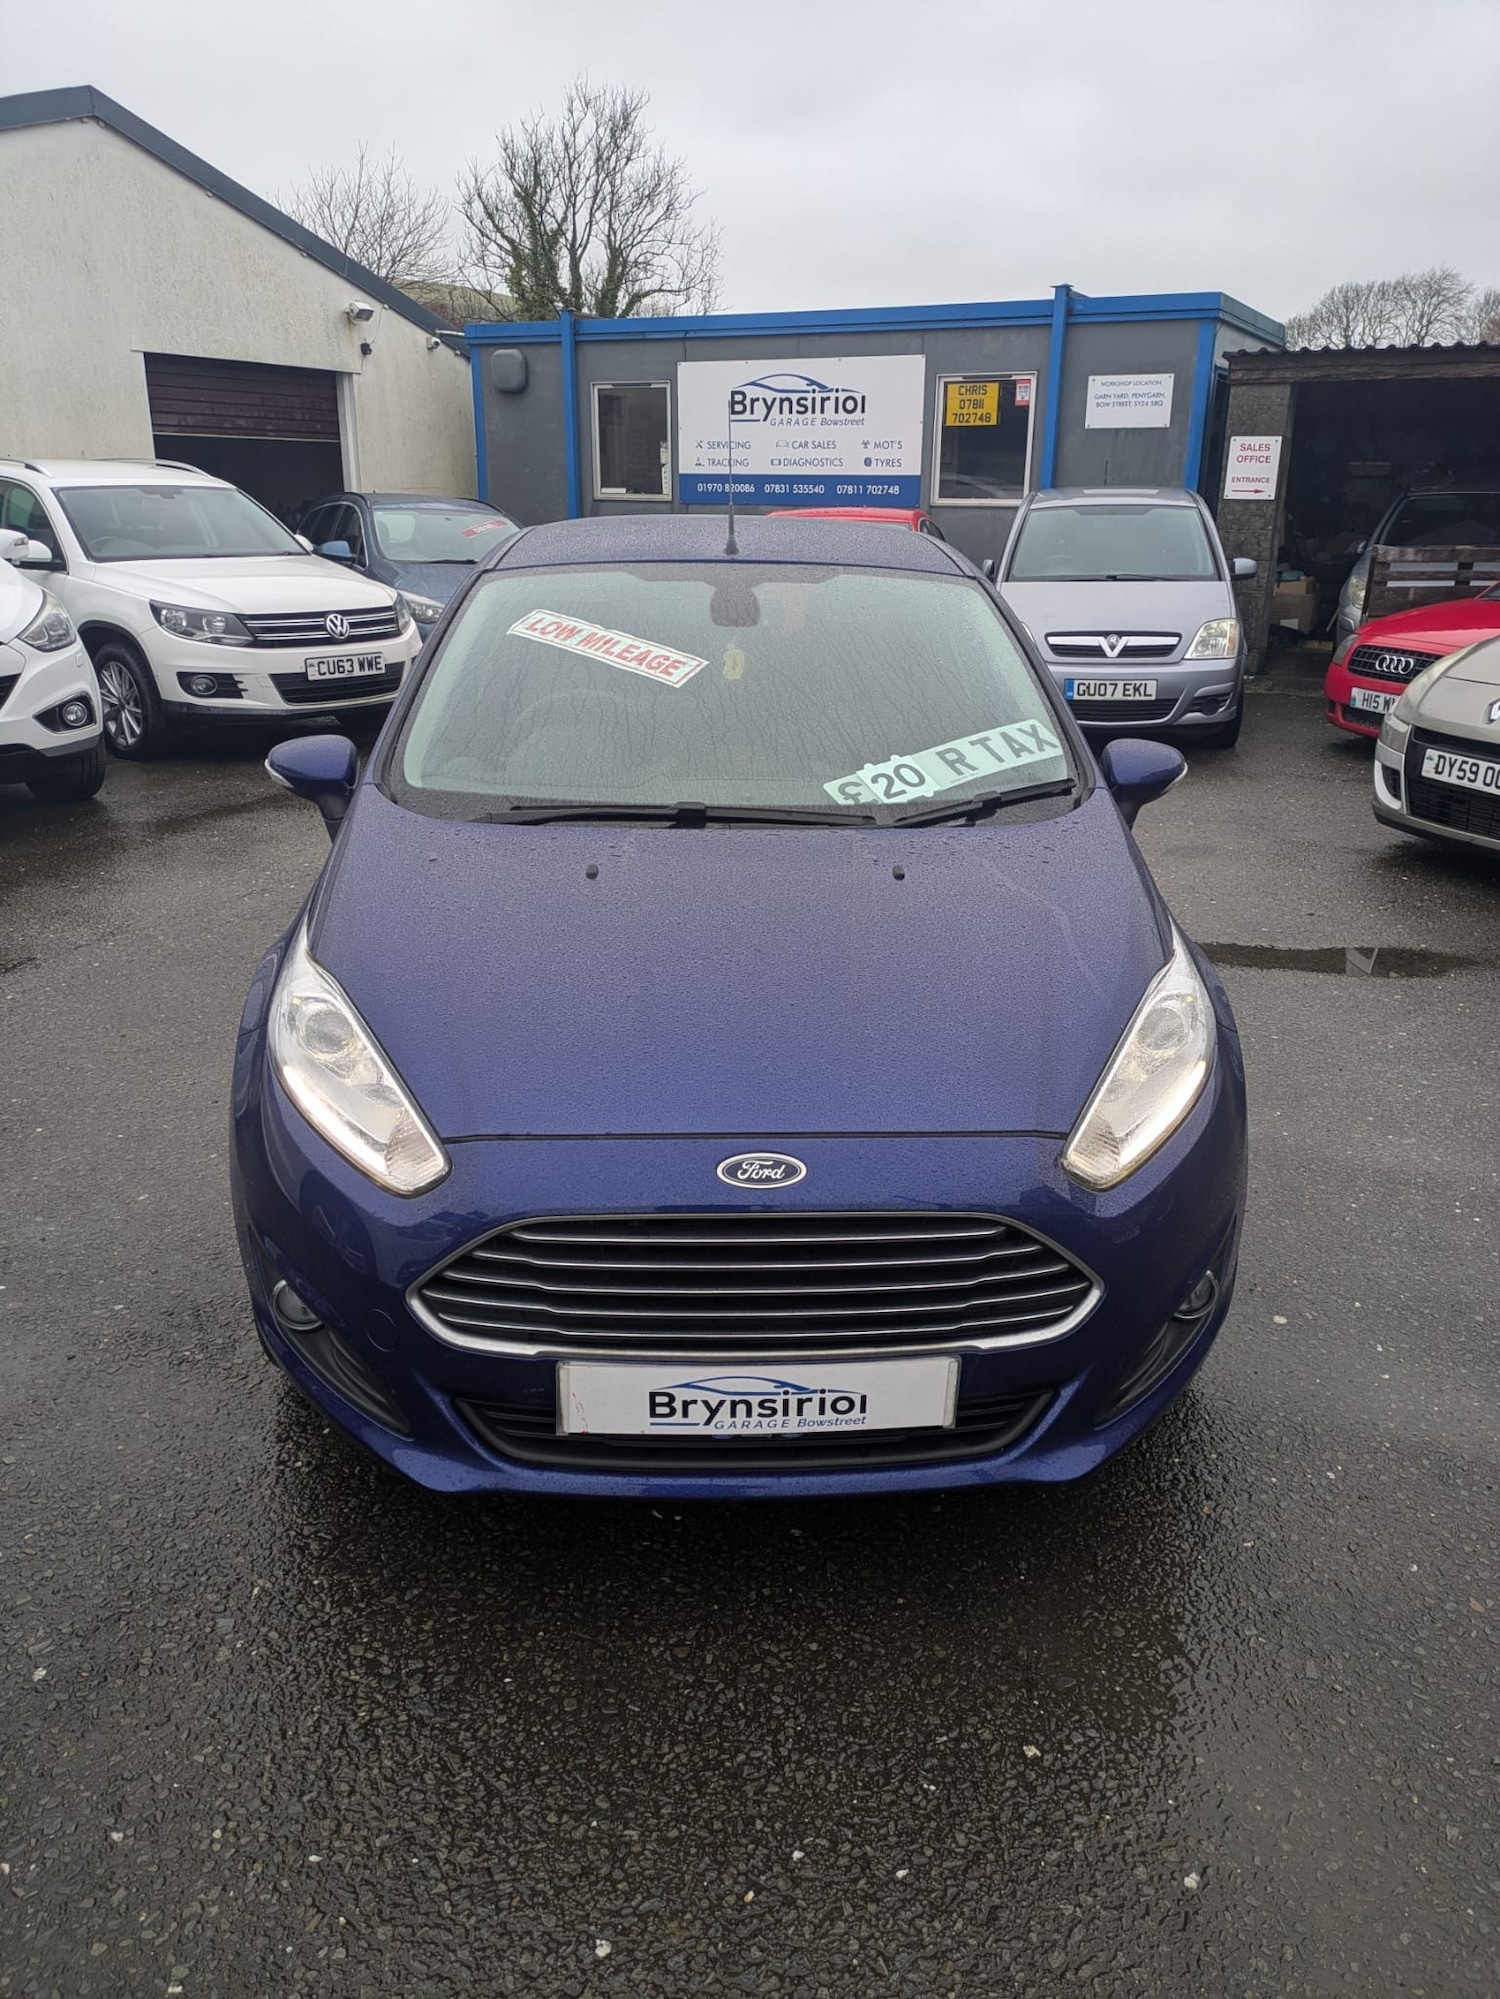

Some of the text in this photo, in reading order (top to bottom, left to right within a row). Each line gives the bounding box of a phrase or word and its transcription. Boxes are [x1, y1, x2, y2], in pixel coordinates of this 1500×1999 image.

[958, 384, 988, 396] CHRIS
[731, 388, 866, 421] Brynsiriol
[959, 398, 985, 410] 07811
[770, 417, 865, 427] GARAGE Bowstreet
[952, 412, 992, 424] 702748
[707, 440, 751, 450] SERVICING
[791, 440, 837, 450] CAR SALES
[873, 440, 903, 450] MOT'S
[1240, 443, 1271, 452] SALES
[783, 457, 844, 467] DIAGNOSTICS
[874, 458, 902, 467] TYRES
[1236, 455, 1272, 464] OFFICE
[1231, 476, 1271, 484] ENTRANCE
[697, 483, 755, 493] 01970 820086
[764, 484, 825, 494] 07831 535540
[836, 485, 900, 494] 07811 702748
[525, 617, 687, 677] LOW MILEAGE
[317, 655, 383, 676] CU63 WWE
[1076, 682, 1153, 697] GU07 EKL
[935, 747, 979, 776] R
[969, 724, 1059, 763] TAX
[1434, 754, 1480, 783] DY59
[737, 1160, 786, 1179] Ford
[649, 1389, 867, 1426] Brynsiriol
[714, 1415, 866, 1430] GARAGE Bowstreet
